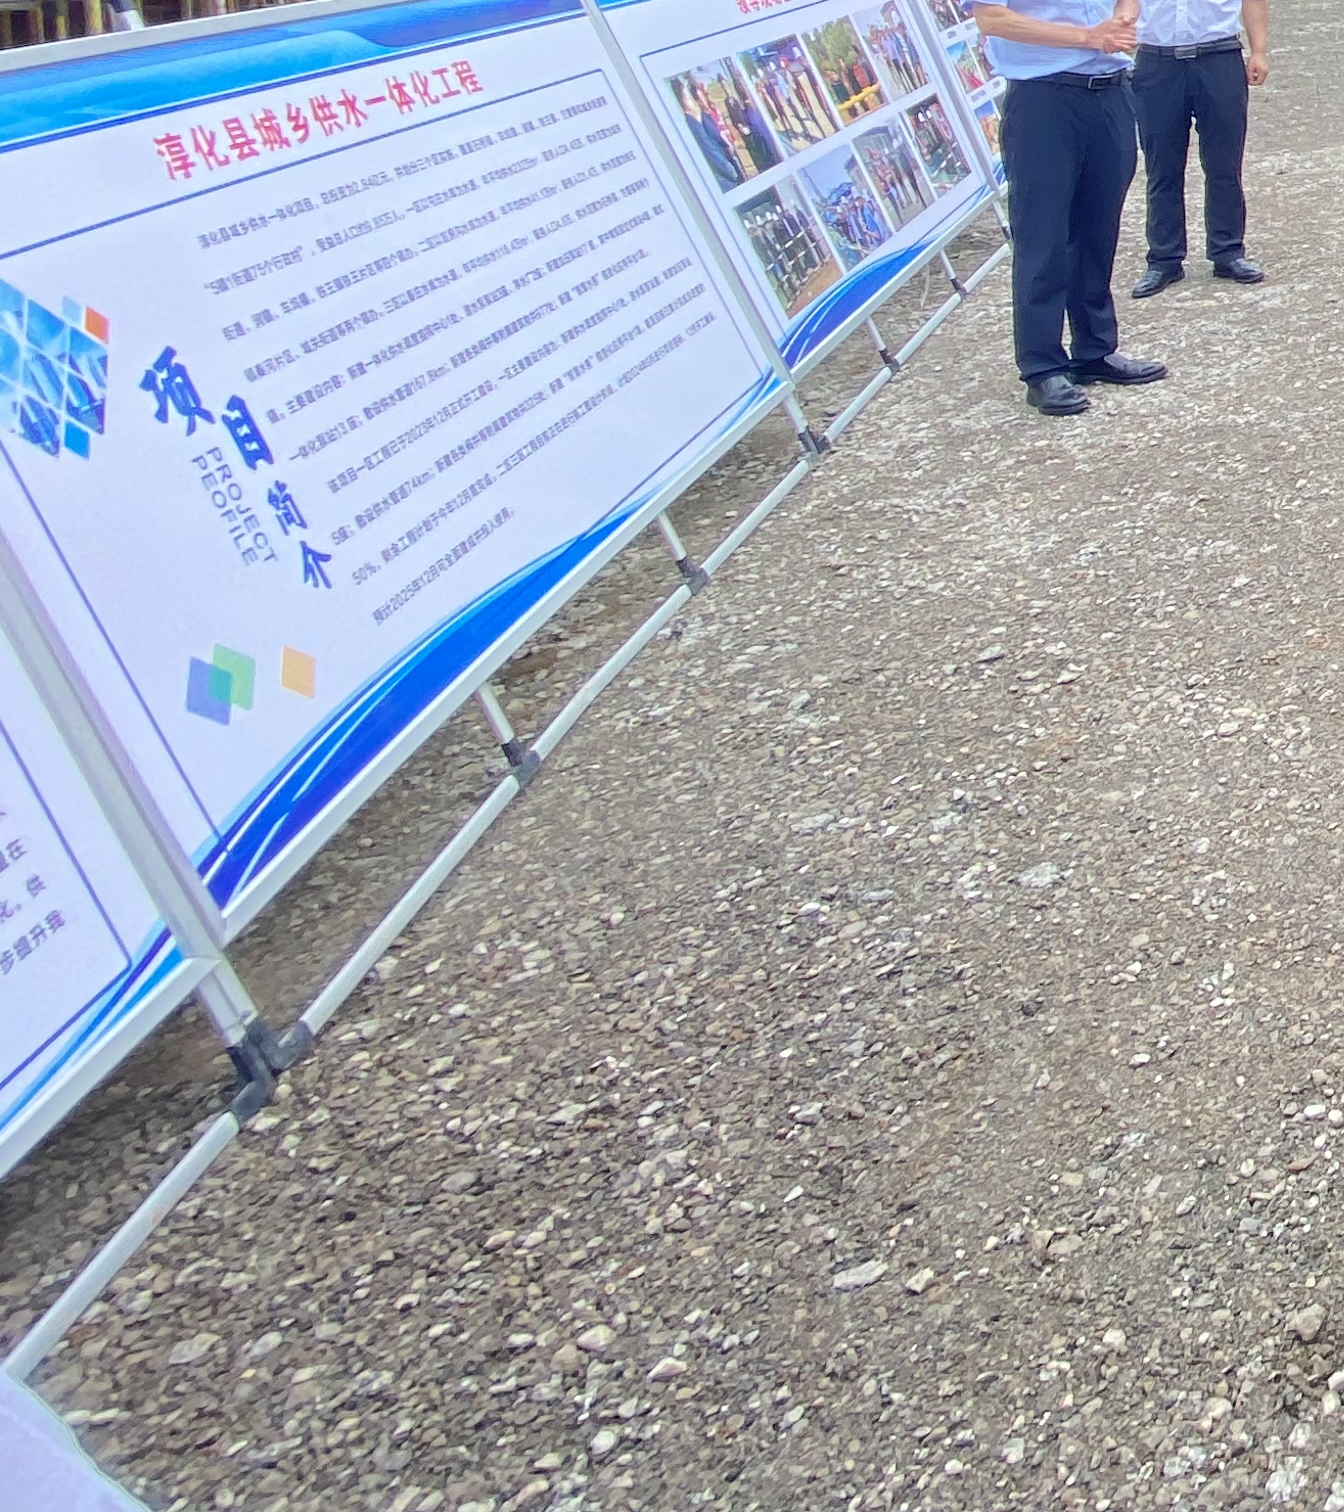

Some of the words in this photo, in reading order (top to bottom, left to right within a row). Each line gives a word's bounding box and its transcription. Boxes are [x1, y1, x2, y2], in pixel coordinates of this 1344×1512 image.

[153, 59, 484, 181] 淳化县城乡供水一体化工程
